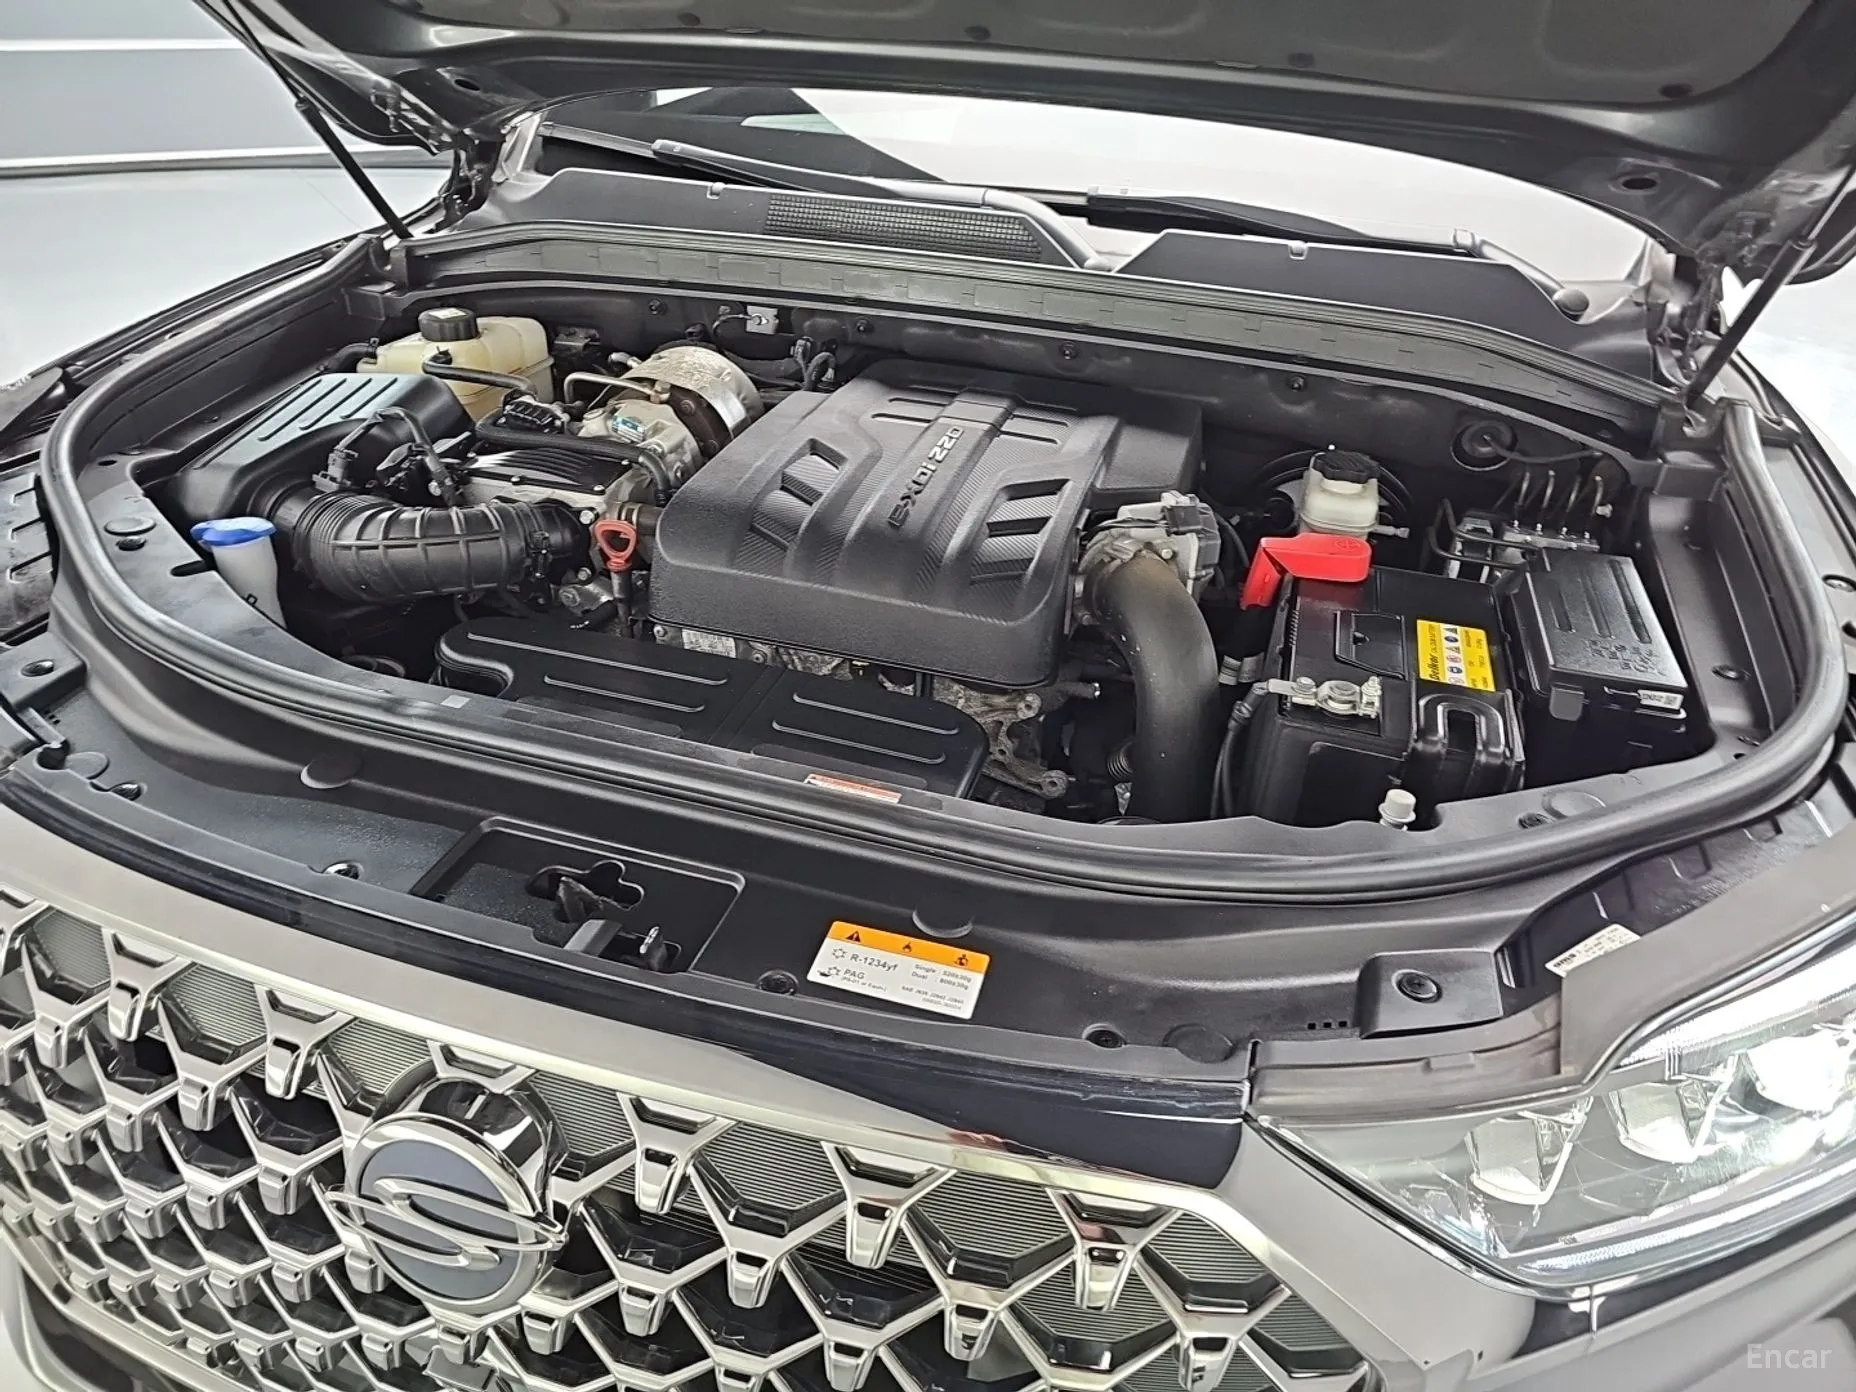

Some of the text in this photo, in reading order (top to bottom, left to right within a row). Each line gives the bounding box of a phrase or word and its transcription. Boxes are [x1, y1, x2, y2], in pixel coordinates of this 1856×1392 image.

[927, 426, 965, 463] 220
[850, 953, 898, 971] R-1234yf
[844, 968, 865, 980] PAG
